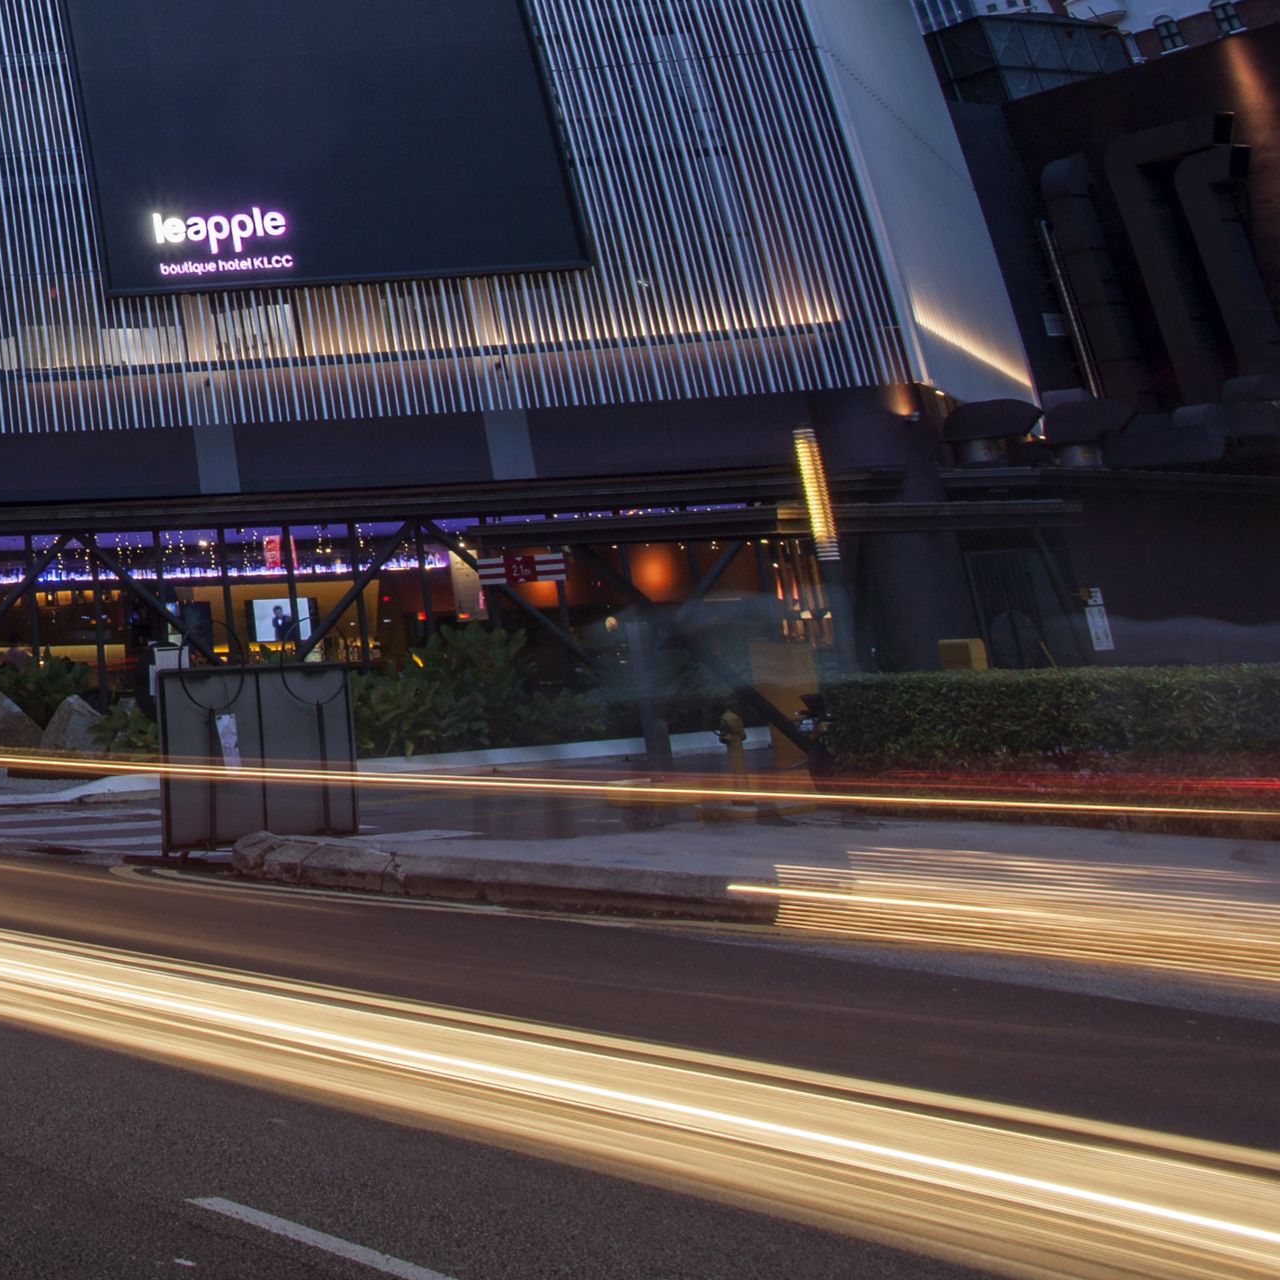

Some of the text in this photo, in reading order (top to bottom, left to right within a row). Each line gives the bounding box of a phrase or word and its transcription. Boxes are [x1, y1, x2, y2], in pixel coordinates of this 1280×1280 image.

[152, 206, 287, 255] leapple
[160, 254, 294, 275] boutique hotel KLCC
